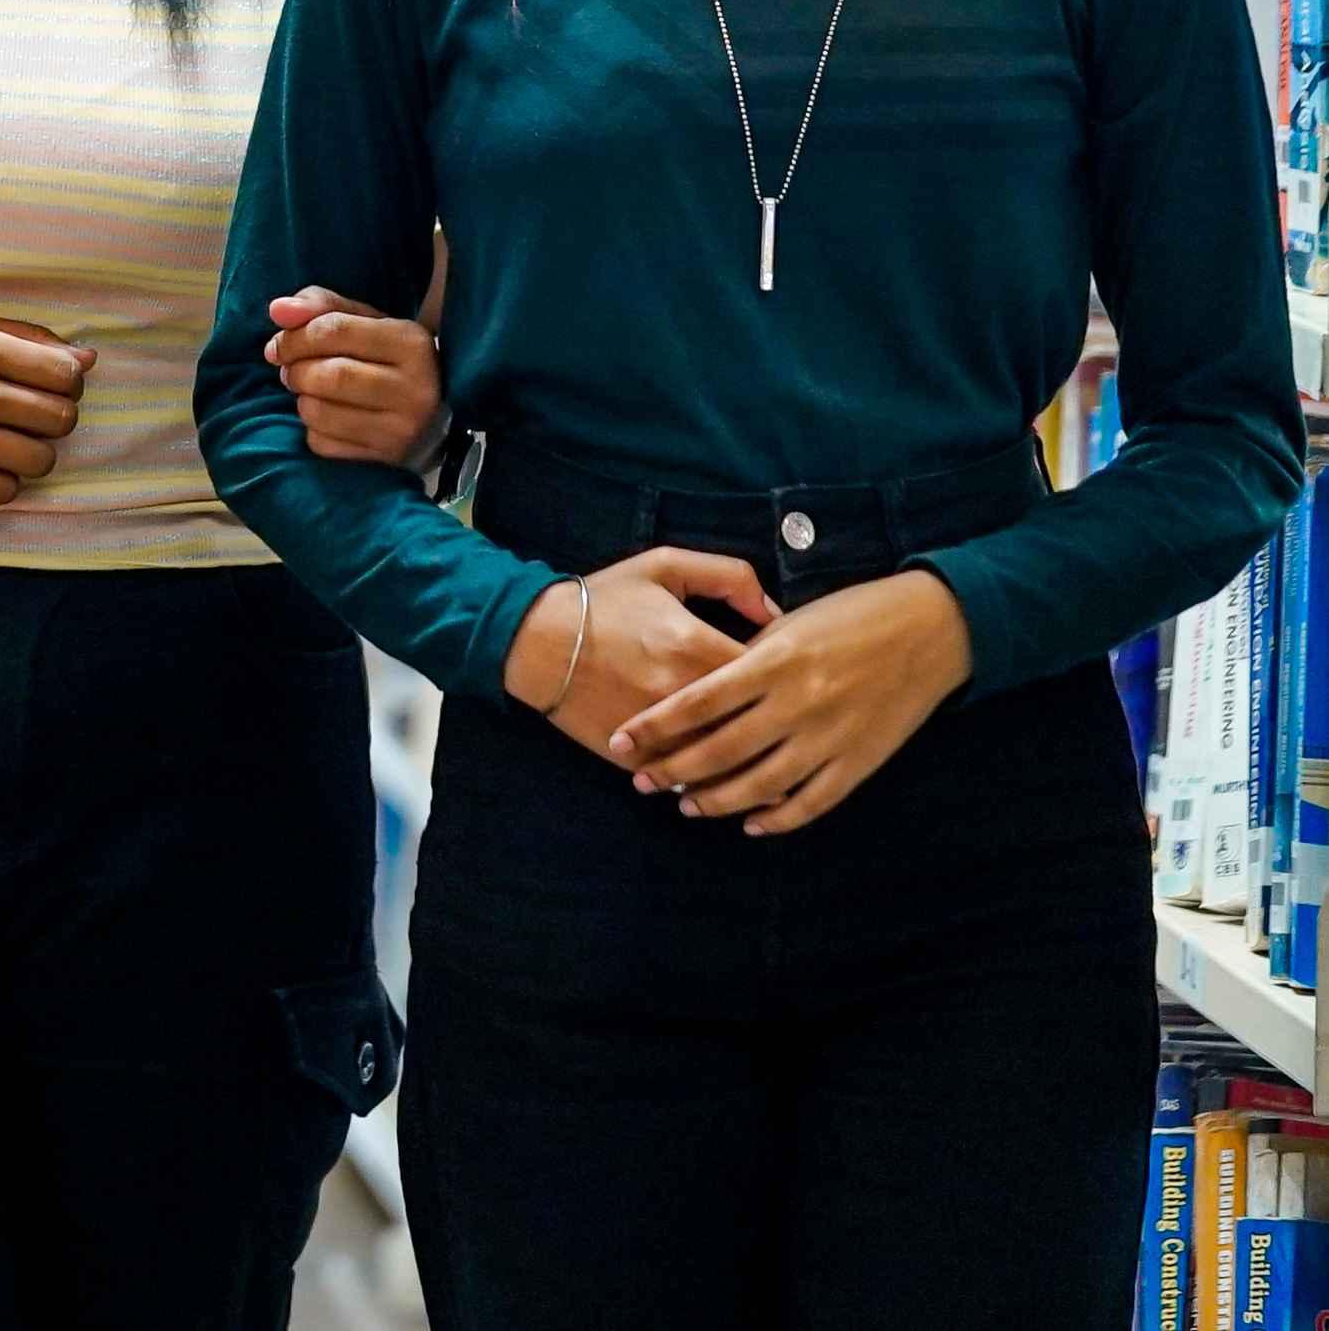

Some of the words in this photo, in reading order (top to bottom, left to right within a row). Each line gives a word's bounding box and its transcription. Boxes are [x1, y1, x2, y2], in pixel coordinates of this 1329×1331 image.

[1251, 549, 1265, 671] UNDATION
[1220, 614, 1238, 750] ENGINEERING
[1156, 1146, 1187, 1232] Building
[1217, 1149, 1236, 1245] BUILDING
[1242, 1234, 1272, 1324] Building
